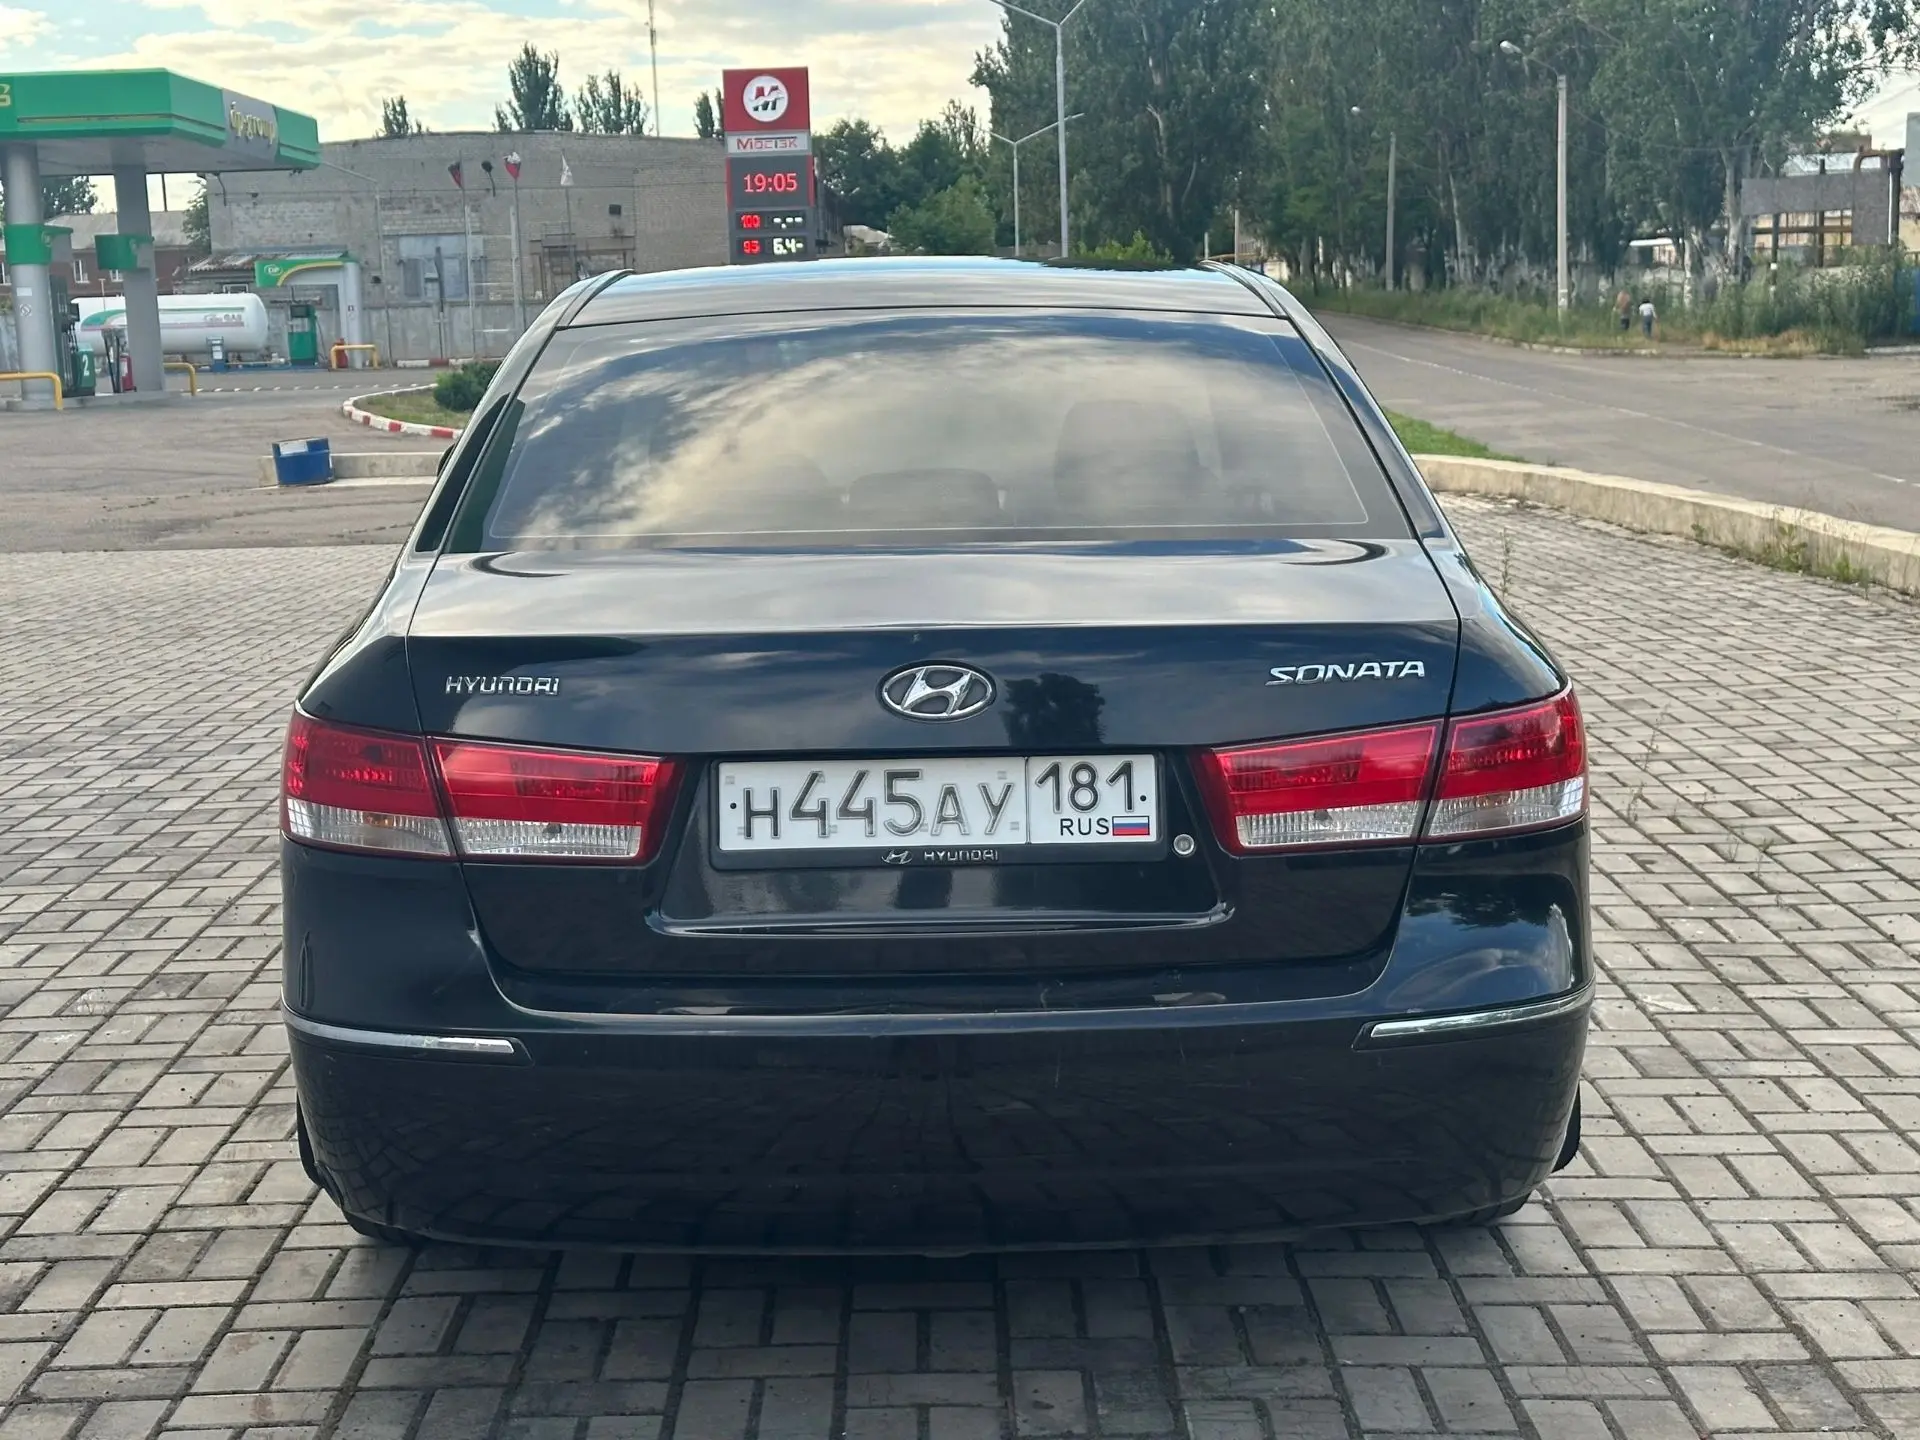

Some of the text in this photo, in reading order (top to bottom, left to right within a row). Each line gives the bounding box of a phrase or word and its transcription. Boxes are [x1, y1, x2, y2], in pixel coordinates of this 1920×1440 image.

[743, 173, 798, 193] 19:05
[741, 214, 761, 229] 100
[743, 240, 761, 254] 95
[82, 354, 90, 377] 2
[1265, 660, 1425, 686] SONATA
[445, 676, 560, 695] HYUNDAI
[1035, 760, 1135, 814] 181
[1059, 817, 1110, 836] RUS
[923, 850, 999, 861] HYUNDAI
